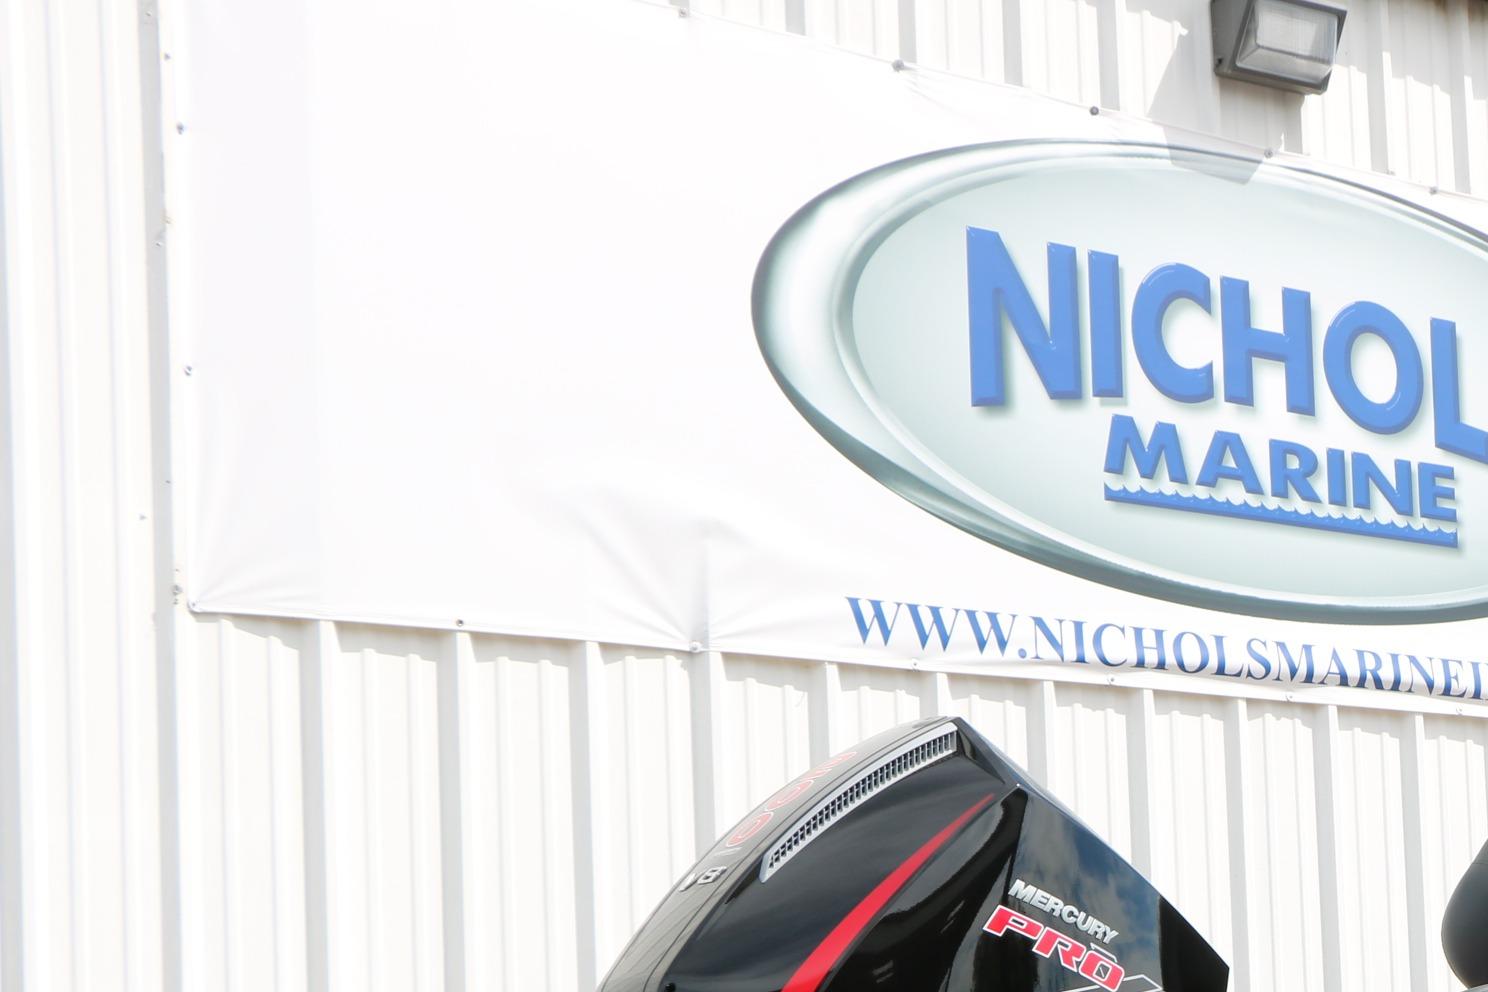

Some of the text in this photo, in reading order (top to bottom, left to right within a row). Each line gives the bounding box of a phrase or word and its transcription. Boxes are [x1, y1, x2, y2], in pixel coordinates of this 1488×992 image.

[1103, 412, 1460, 524] MARINE
[982, 903, 1126, 992] PRO
[1008, 878, 1120, 945] MERCURY
